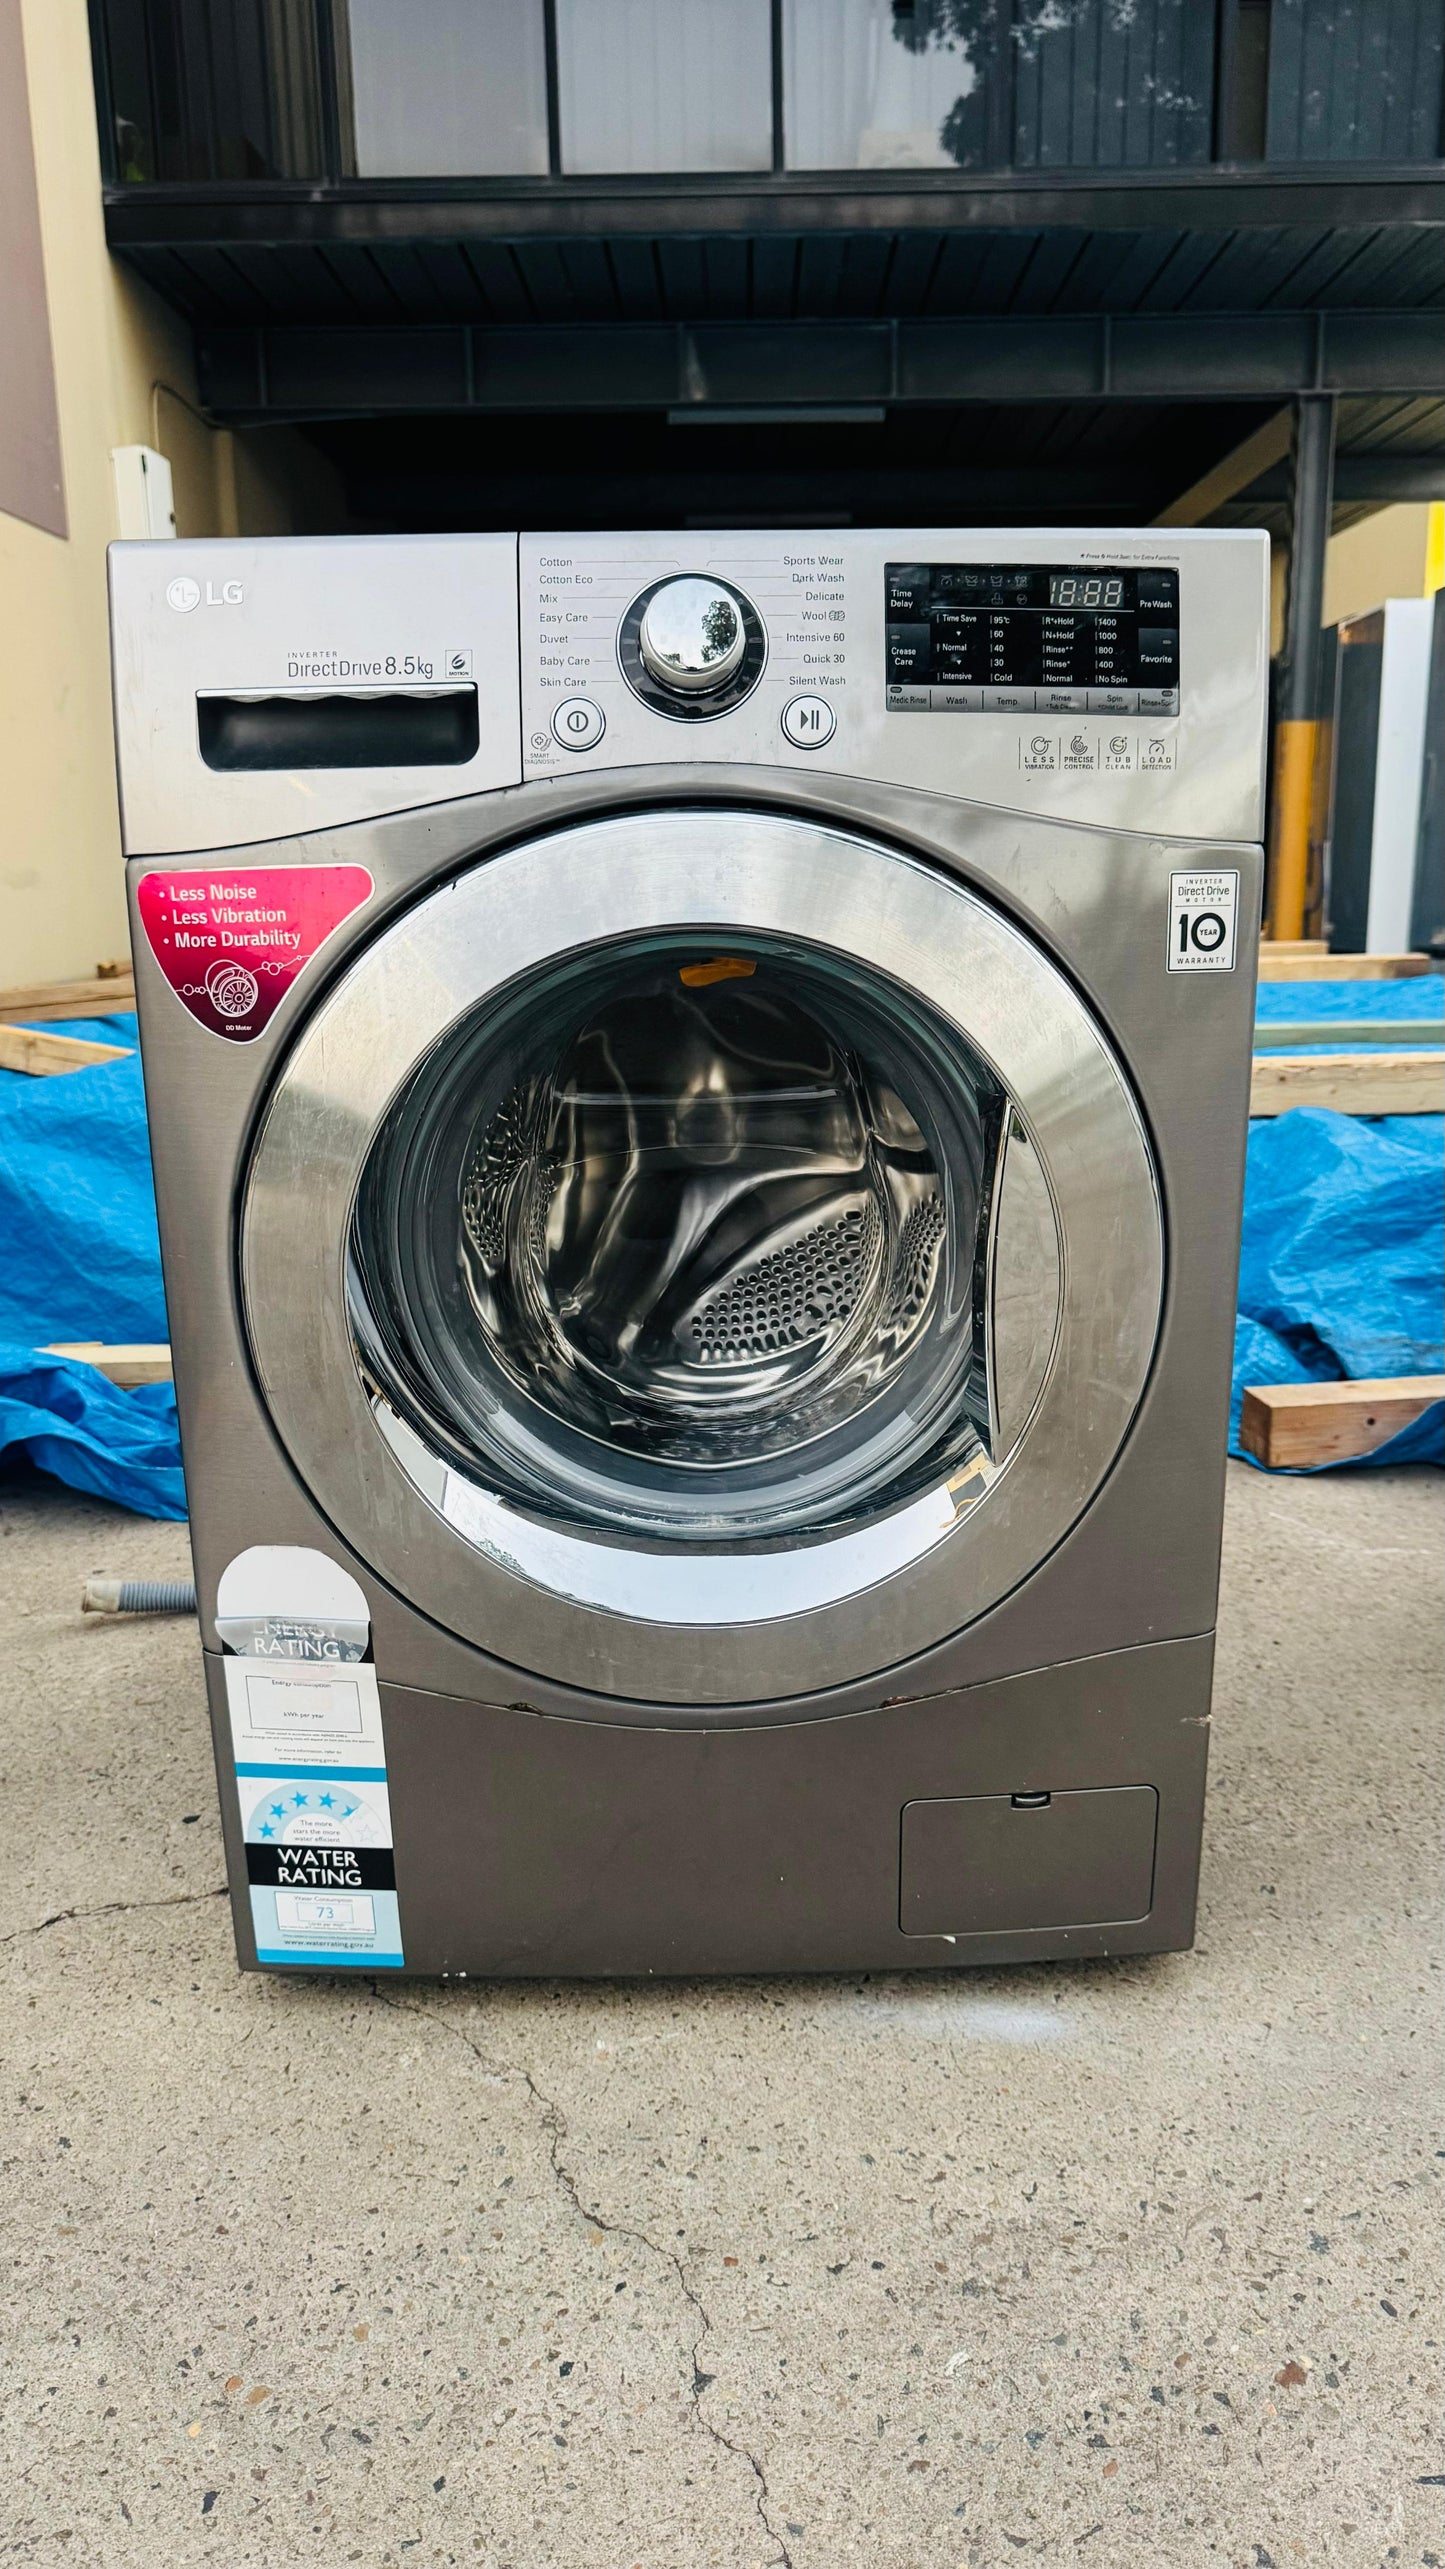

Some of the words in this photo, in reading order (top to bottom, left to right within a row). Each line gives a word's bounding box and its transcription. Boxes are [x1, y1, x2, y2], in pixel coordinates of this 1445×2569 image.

[540, 557, 573, 567] Cotton
[783, 556, 815, 567] Sports
[818, 556, 844, 565] Wear
[540, 575, 573, 584] Cotton
[575, 575, 593, 584] Eco
[792, 573, 815, 583] Dark
[817, 573, 845, 583] Wash
[206, 580, 244, 606] LG
[805, 592, 845, 601] Delicate
[891, 590, 912, 598] Time
[539, 594, 558, 603] Mix
[890, 600, 914, 609] Delay
[1152, 600, 1172, 609] Wash
[540, 613, 563, 624] Easy
[565, 613, 588, 622] Care
[802, 611, 827, 620] Wool
[942, 614, 959, 622] Time
[960, 614, 977, 623] Save
[1098, 618, 1117, 626] 1400
[786, 632, 831, 642] Intensive
[833, 632, 845, 642] 60
[993, 630, 1003, 638] 60
[1098, 632, 1117, 640] 1000
[540, 634, 569, 644] Duvet
[891, 647, 916, 655] Crease
[942, 643, 967, 651] Normal
[994, 644, 1004, 652] 40
[540, 656, 564, 667] Baby
[567, 656, 590, 665] Care
[803, 654, 831, 664] Quick
[833, 654, 845, 664] 30
[894, 657, 913, 666] Care
[994, 659, 1004, 667] 30
[1140, 655, 1173, 663] Favorite
[385, 656, 433, 680] 8.5kg
[789, 676, 817, 685] Silent
[819, 676, 846, 685] Wash
[942, 672, 972, 680] Intensive
[994, 673, 1013, 682] Cold
[1046, 674, 1073, 682] Normal
[1099, 675, 1109, 683] No
[1110, 675, 1128, 684] Spin
[540, 677, 561, 687] Skin
[564, 677, 587, 686] Care
[909, 696, 927, 704] Rinse
[946, 696, 967, 704] Wash
[997, 697, 1018, 706] Temp
[1106, 694, 1123, 702] Spin
[170, 885, 205, 902] Less
[210, 884, 257, 900] Noise
[1178, 886, 1205, 896] Direct
[1206, 886, 1230, 895] Drive
[172, 909, 207, 925] Less
[211, 907, 286, 924] Vibration
[1179, 912, 1226, 952] 10
[174, 932, 216, 948] More
[221, 929, 301, 950] Durability
[1177, 956, 1226, 964] WARRANTY
[254, 1637, 340, 1658] RATING
[271, 1679, 292, 1687] Energy
[277, 1847, 359, 1868] WATER
[277, 1866, 362, 1887] RATING
[316, 1906, 334, 1919] 73
